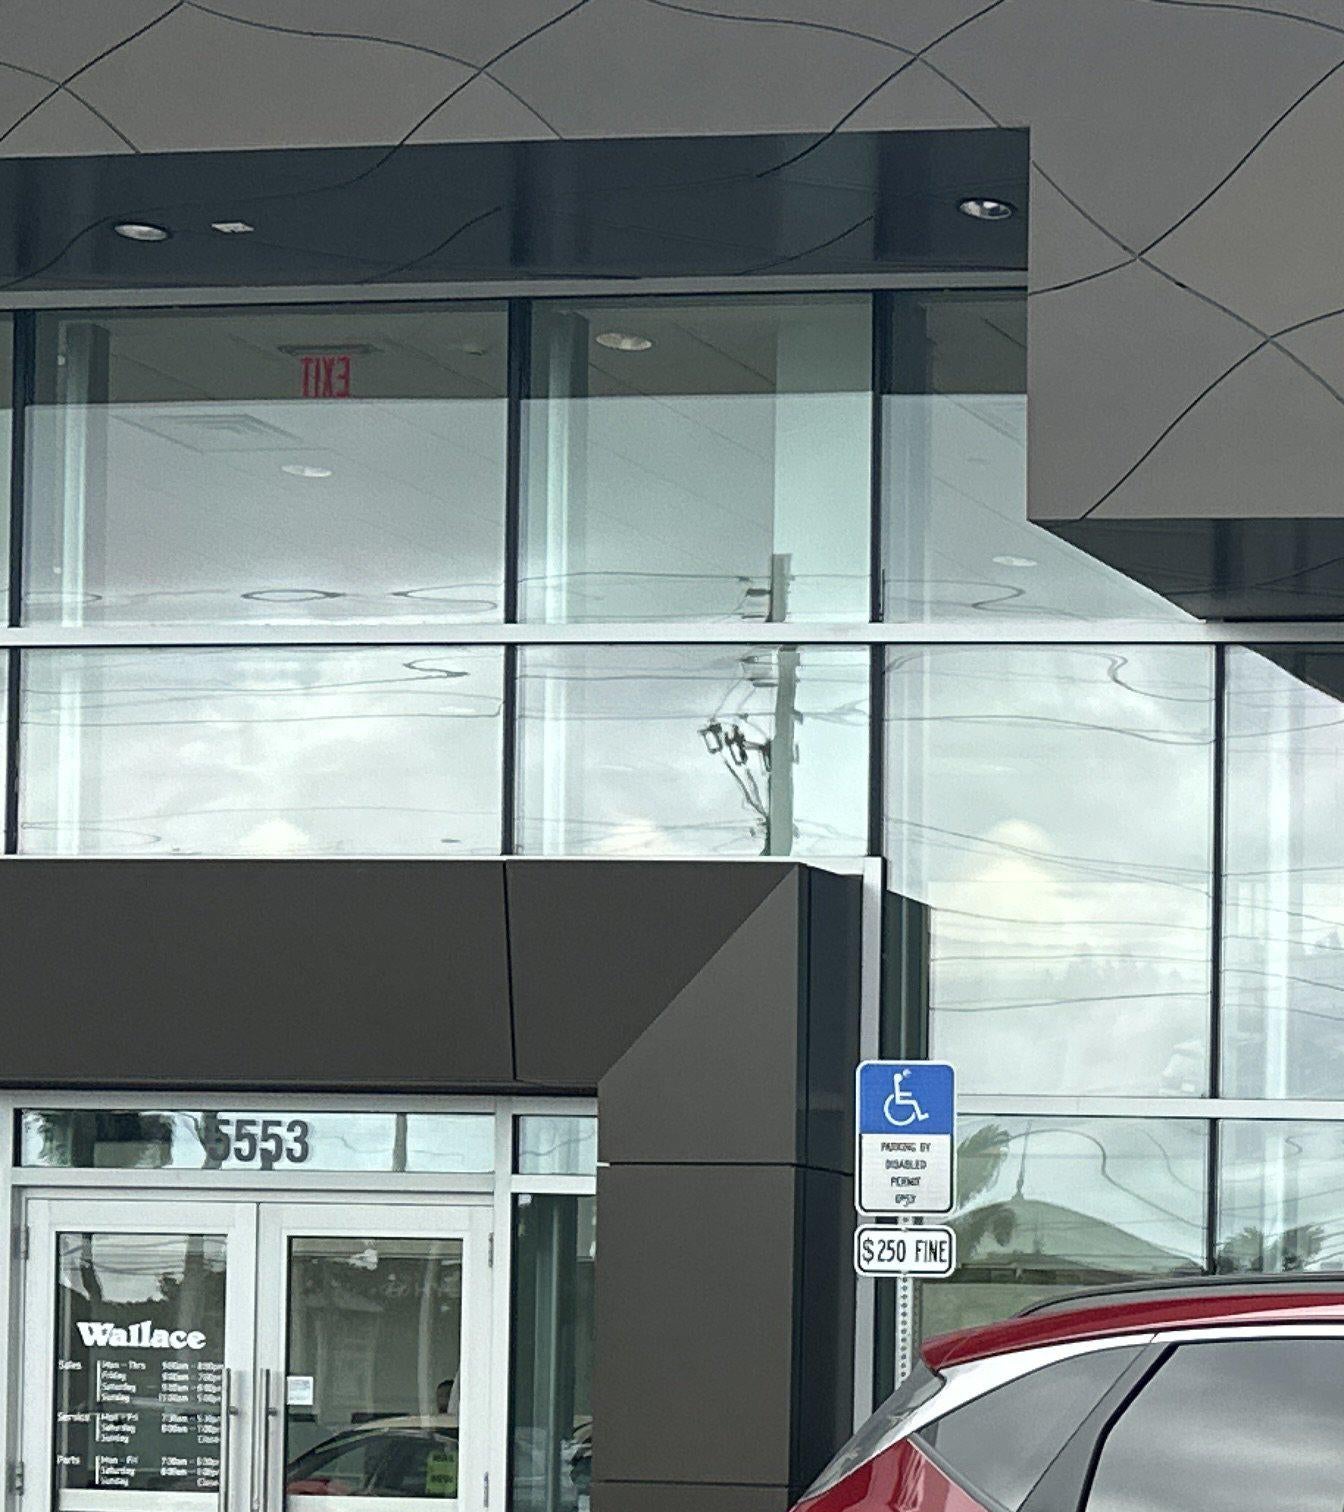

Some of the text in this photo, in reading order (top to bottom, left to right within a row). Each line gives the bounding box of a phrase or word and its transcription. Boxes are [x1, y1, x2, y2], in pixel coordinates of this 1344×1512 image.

[207, 1119, 309, 1163] 5553
[881, 1142, 932, 1153] PARKING BY
[885, 1159, 927, 1170] DISABLED
[890, 1176, 921, 1187] PERMIT
[862, 1237, 948, 1265] $250 FINE
[76, 1320, 207, 1350] Wallace
